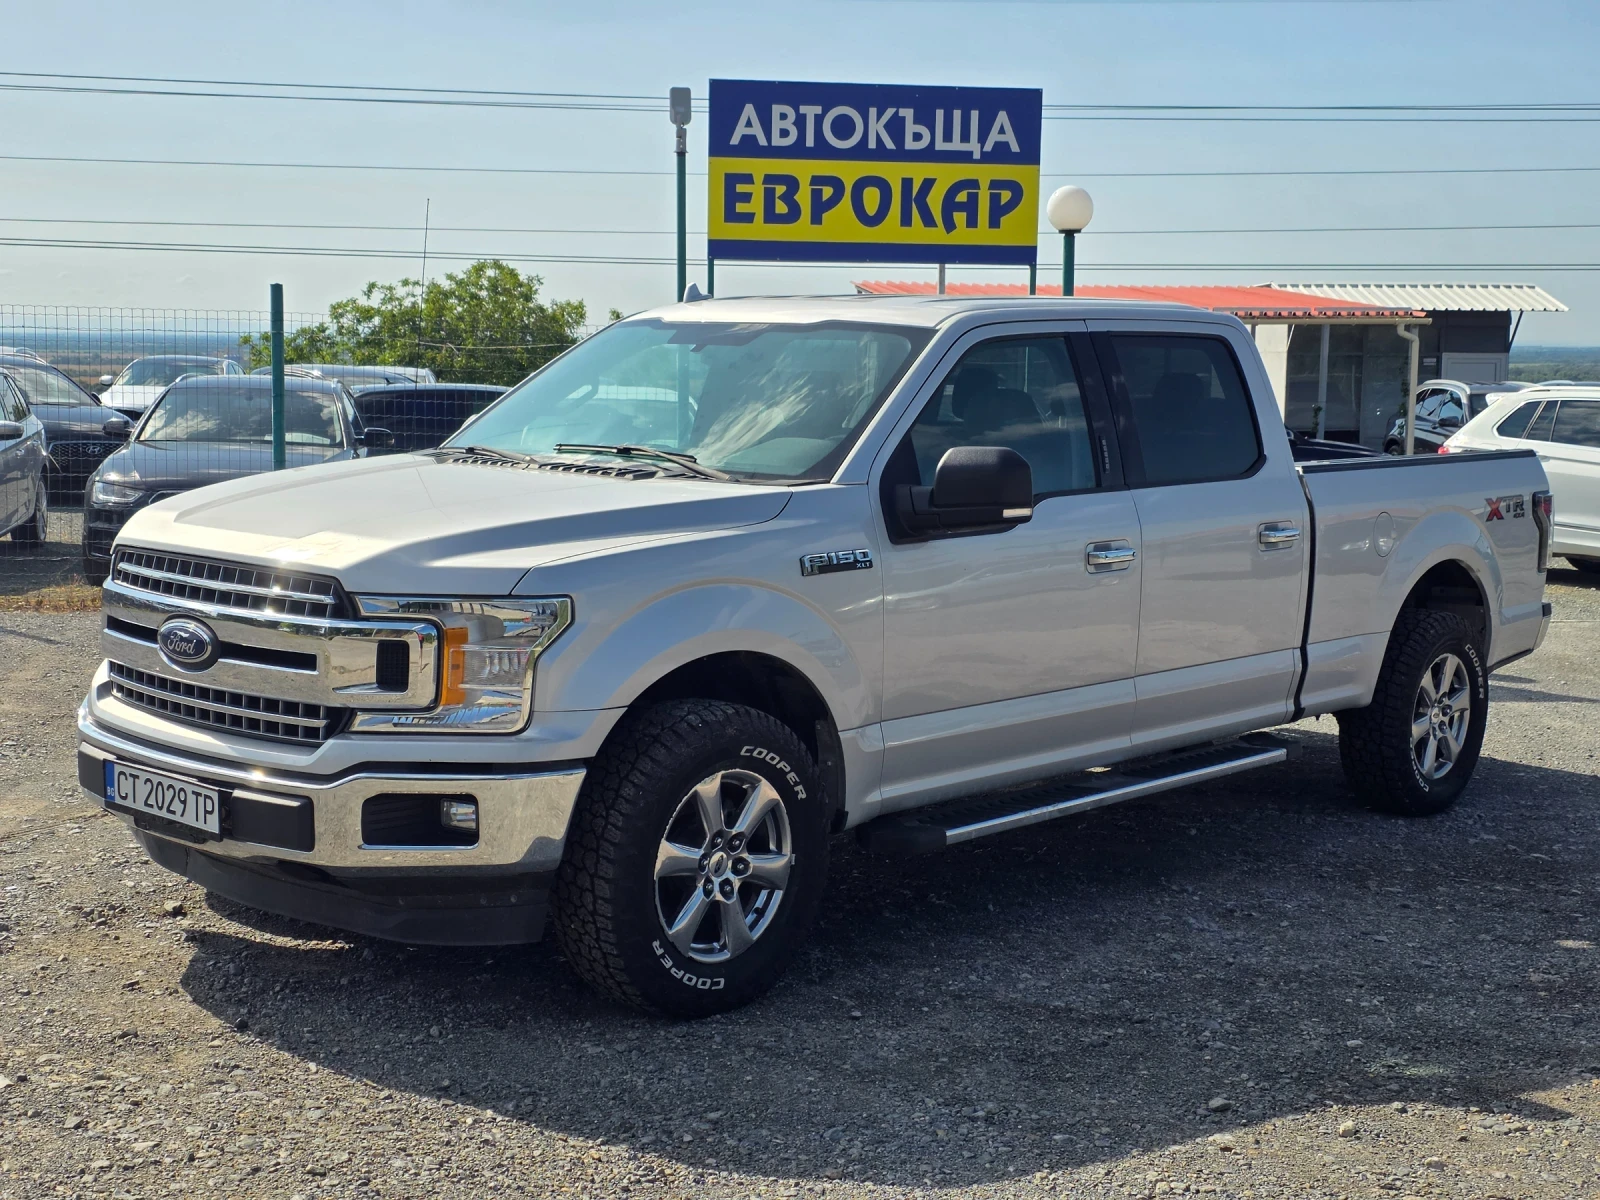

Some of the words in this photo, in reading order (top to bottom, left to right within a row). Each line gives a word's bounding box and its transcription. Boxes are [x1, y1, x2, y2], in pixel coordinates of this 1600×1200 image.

[729, 103, 1021, 159] АВТОКЪЩА
[723, 172, 1024, 235] ЕВРОКАР
[1484, 494, 1525, 522] XTR
[856, 561, 870, 569] XLT
[167, 630, 196, 654] Ford
[1465, 643, 1485, 699] COOPER
[106, 786, 115, 796] BG
[739, 745, 807, 800] COOPER
[1409, 737, 1430, 792] COO
[117, 771, 140, 804] CT
[144, 778, 188, 817] 2029
[191, 790, 215, 824] TP
[652, 939, 725, 990] COOPER
